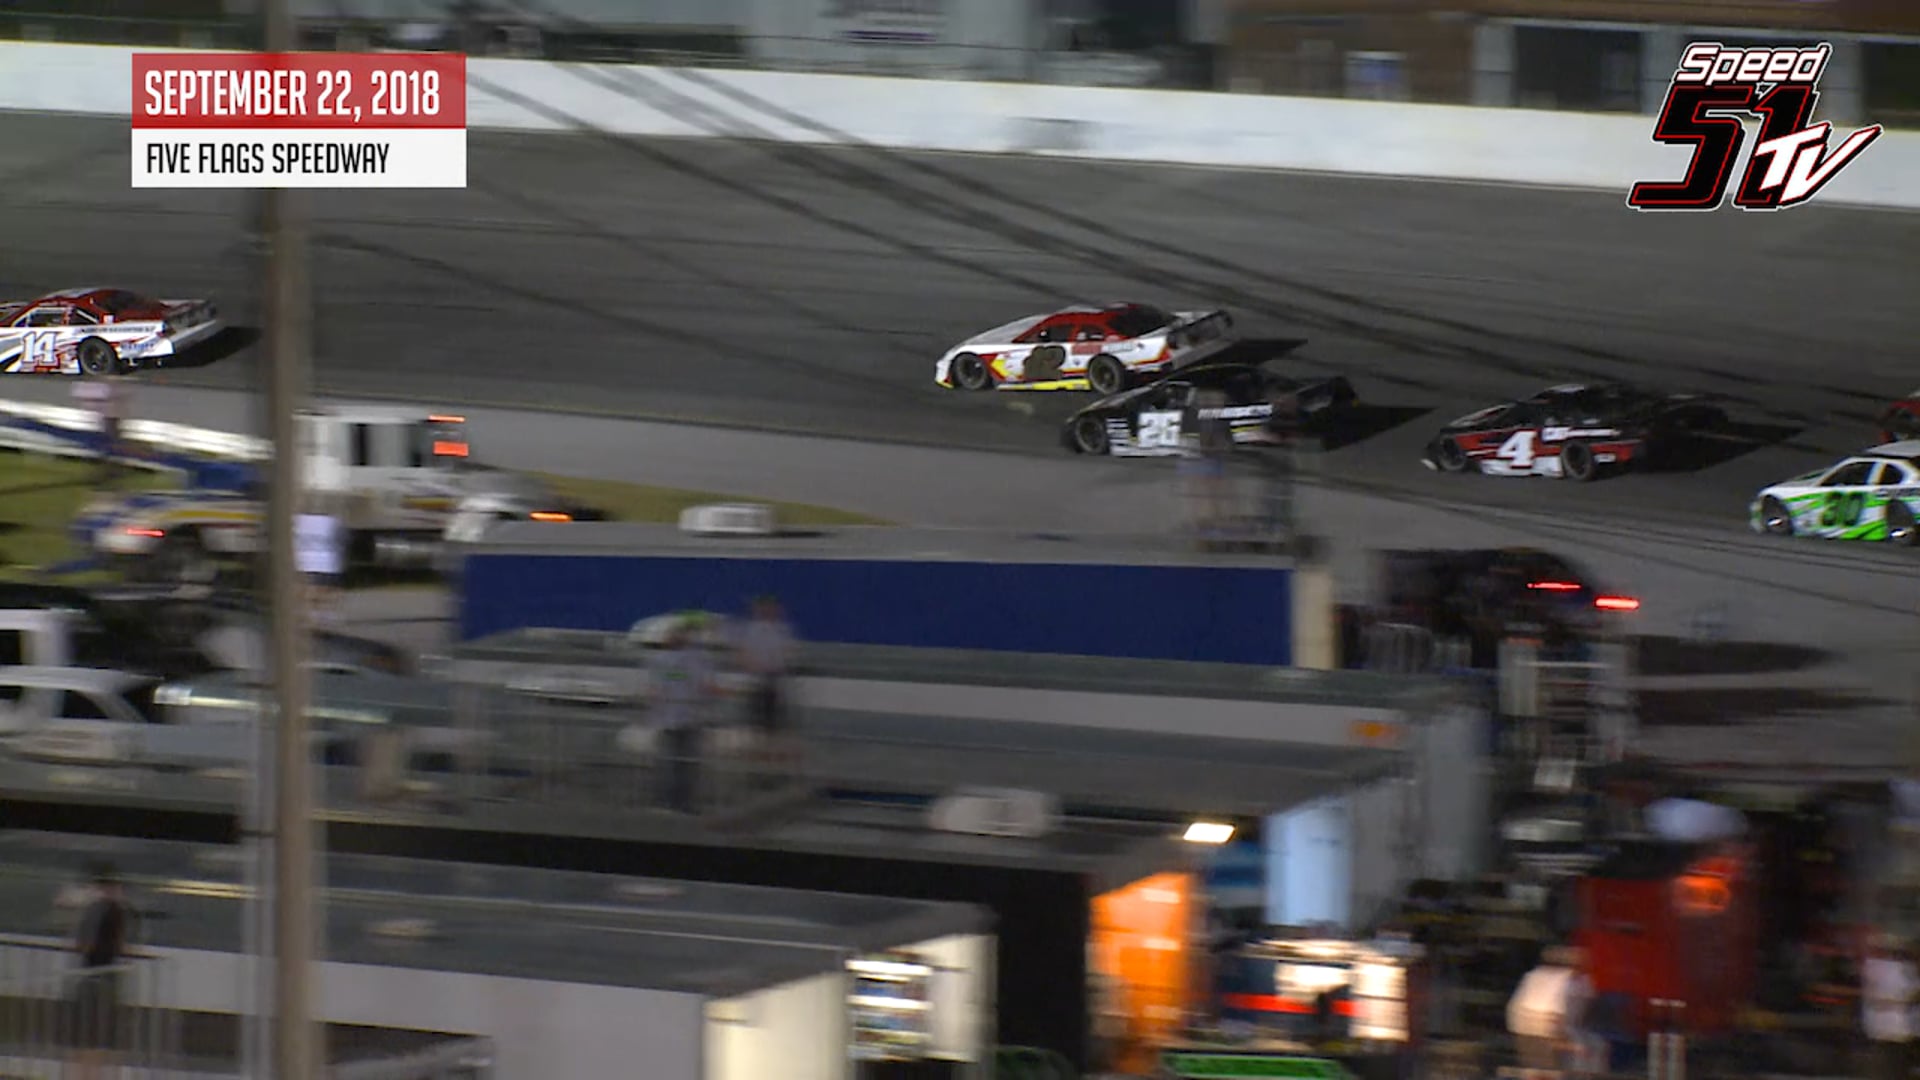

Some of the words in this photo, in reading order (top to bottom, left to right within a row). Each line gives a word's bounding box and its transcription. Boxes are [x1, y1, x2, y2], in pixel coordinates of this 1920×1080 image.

[22, 331, 59, 367] 14
[1138, 411, 1183, 448] 26
[1498, 430, 1538, 468] 4
